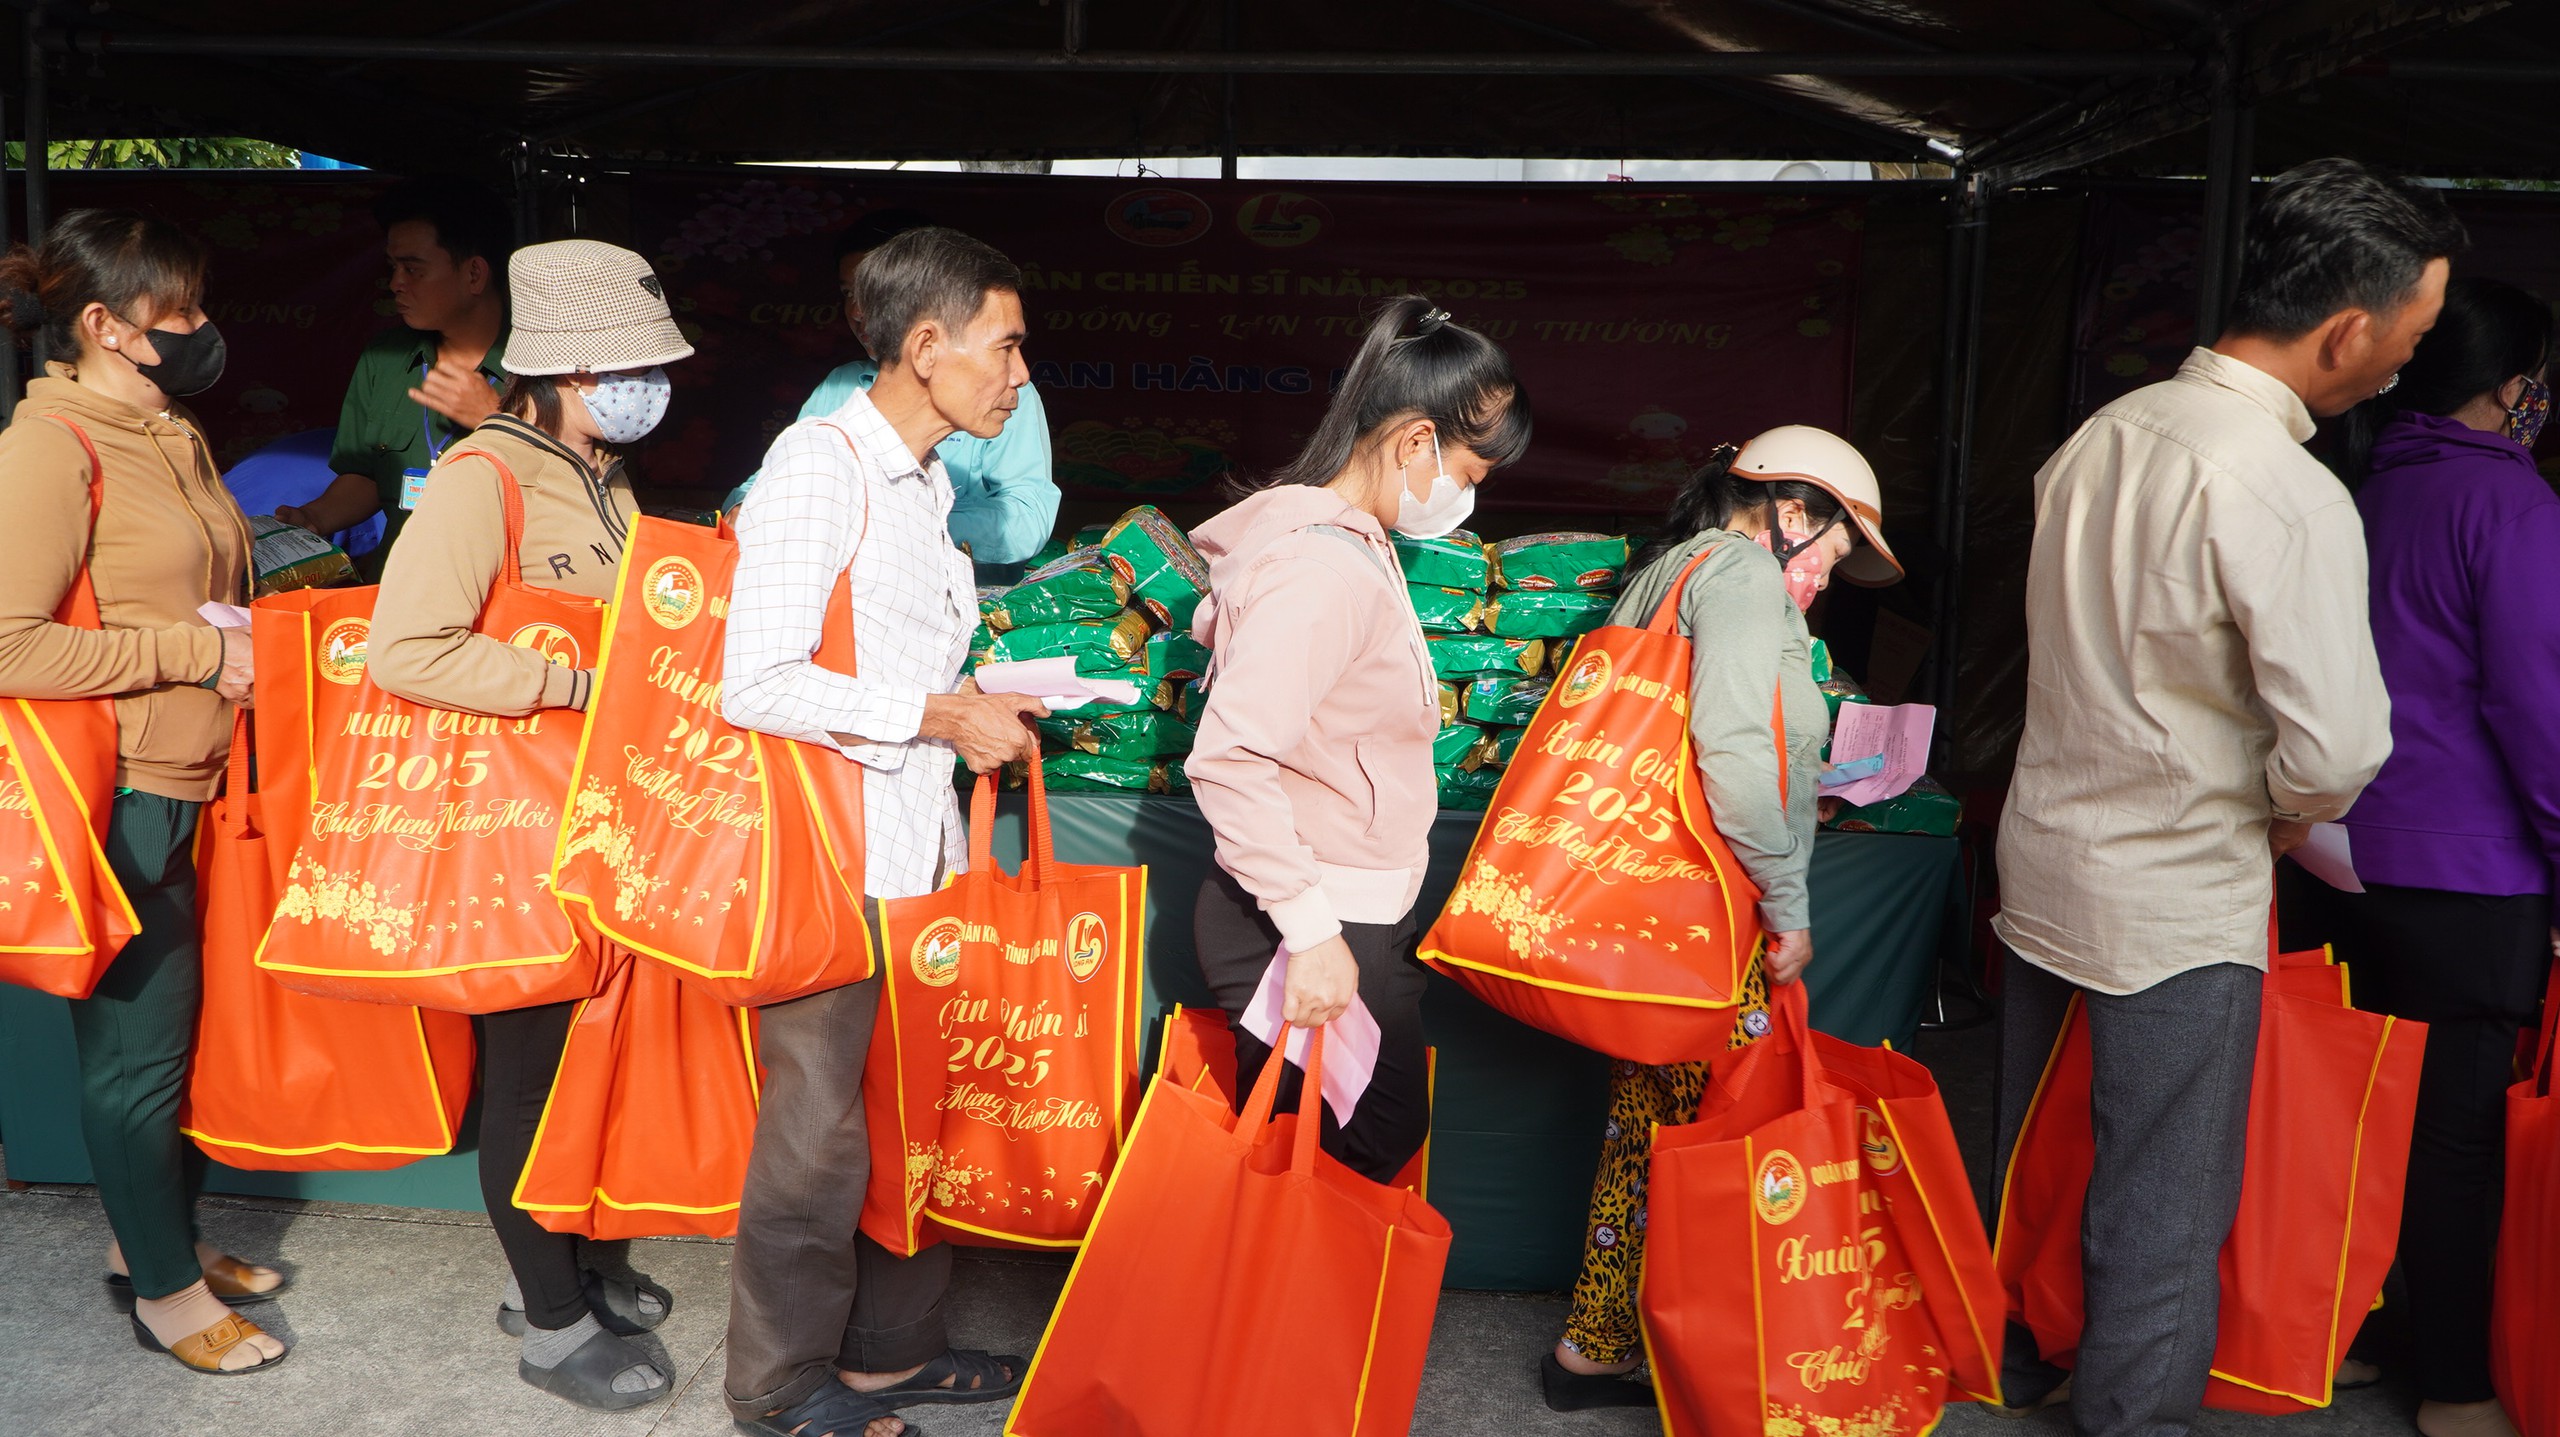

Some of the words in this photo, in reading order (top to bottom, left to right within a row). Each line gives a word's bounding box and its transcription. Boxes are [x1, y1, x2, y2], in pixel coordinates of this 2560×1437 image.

[1019, 260, 1082, 291] ÂN
[1093, 258, 1240, 294] CHIẾN
[1248, 267, 1291, 296] SĨ
[1300, 267, 1407, 298] NĂM
[1418, 278, 1528, 300] 2025
[206, 300, 317, 329] ƯƠNG
[749, 302, 841, 330] CHỢ
[1043, 303, 1174, 338] ĐỒNG
[1461, 312, 1519, 341] ÊU
[1533, 317, 1733, 350] THƯƠNG
[1029, 361, 1114, 390] AN
[1131, 356, 1313, 395] HÀNG
[548, 553, 577, 580] R
[589, 542, 615, 566] N
[648, 645, 714, 708] Xuân
[1537, 719, 1623, 768] Xuân
[312, 801, 370, 842] Chúc
[436, 800, 500, 838] Năm
[487, 799, 554, 829] Mới
[1551, 771, 1680, 842] 2025
[1005, 940, 1030, 965] TỈNH
[1041, 938, 1059, 957] AN
[947, 1035, 1054, 1089] 2025
[1036, 1097, 1102, 1133] Mới
[1597, 1228, 1614, 1244] CK
